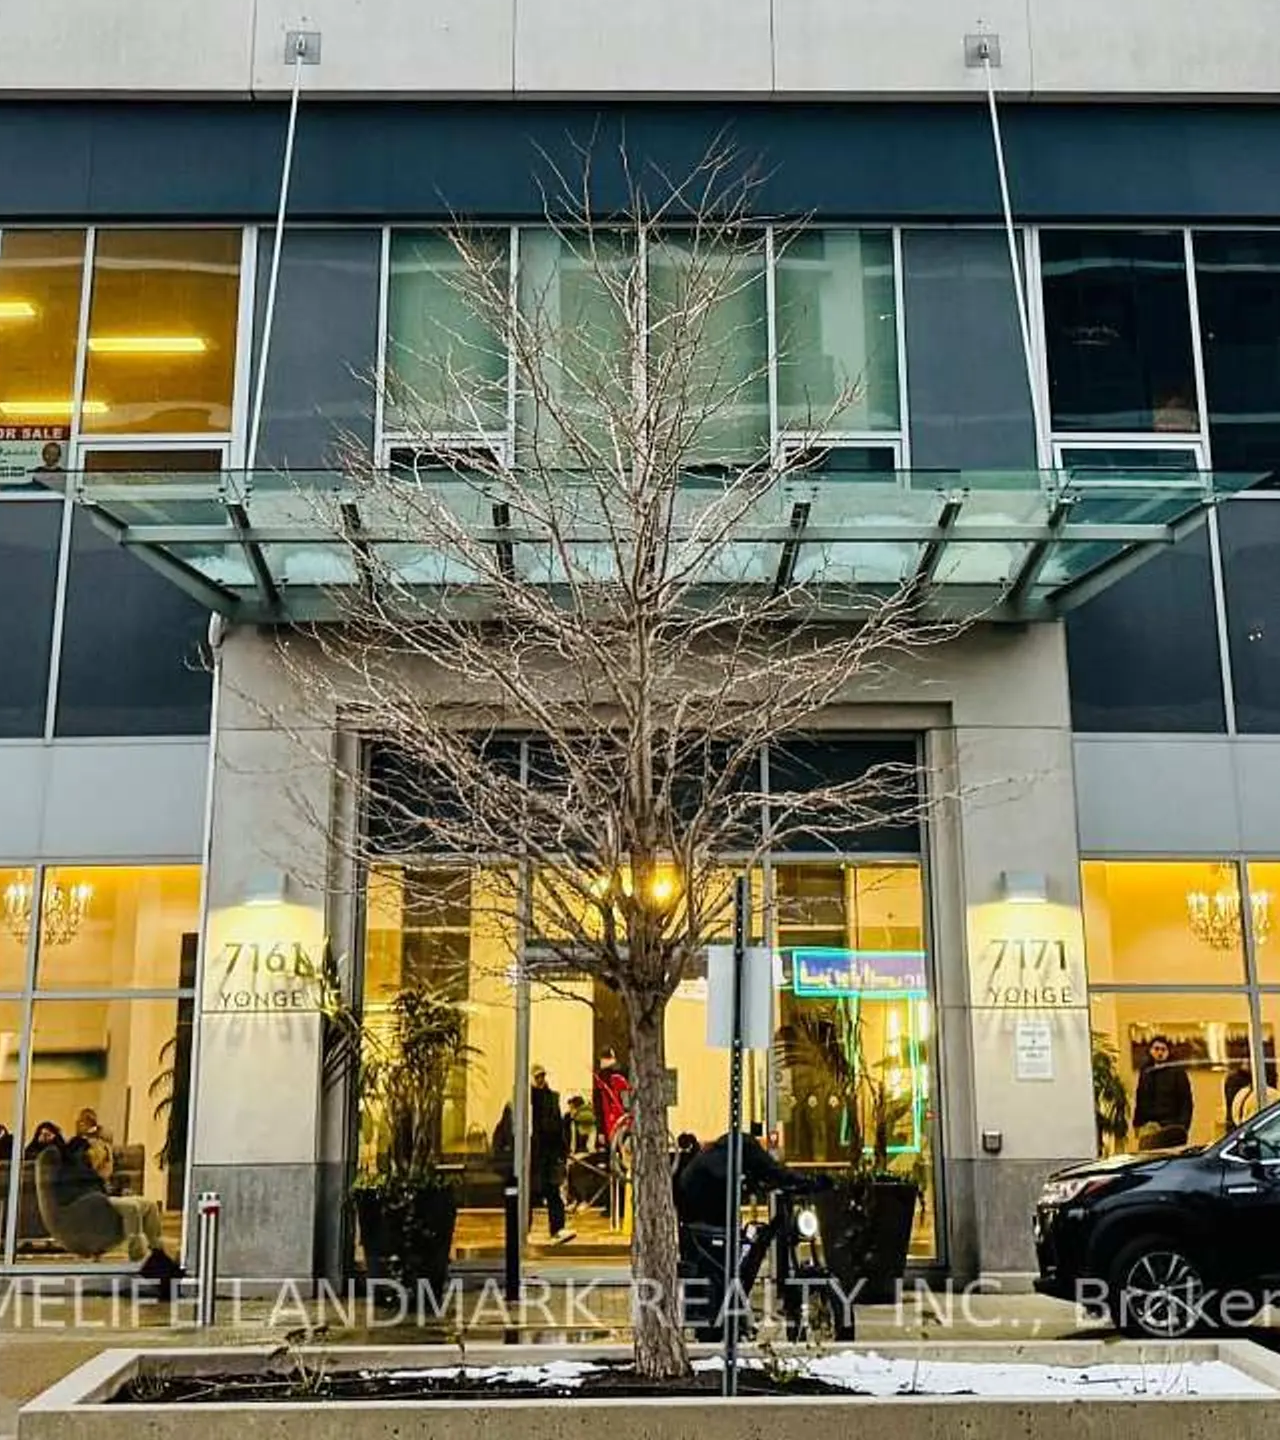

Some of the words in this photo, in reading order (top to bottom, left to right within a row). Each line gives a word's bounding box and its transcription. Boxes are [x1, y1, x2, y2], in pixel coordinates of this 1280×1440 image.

[21, 427, 64, 440] SALE
[989, 939, 1067, 970] 7171
[220, 990, 304, 1008] YONGE
[988, 986, 1074, 1004] YONGE
